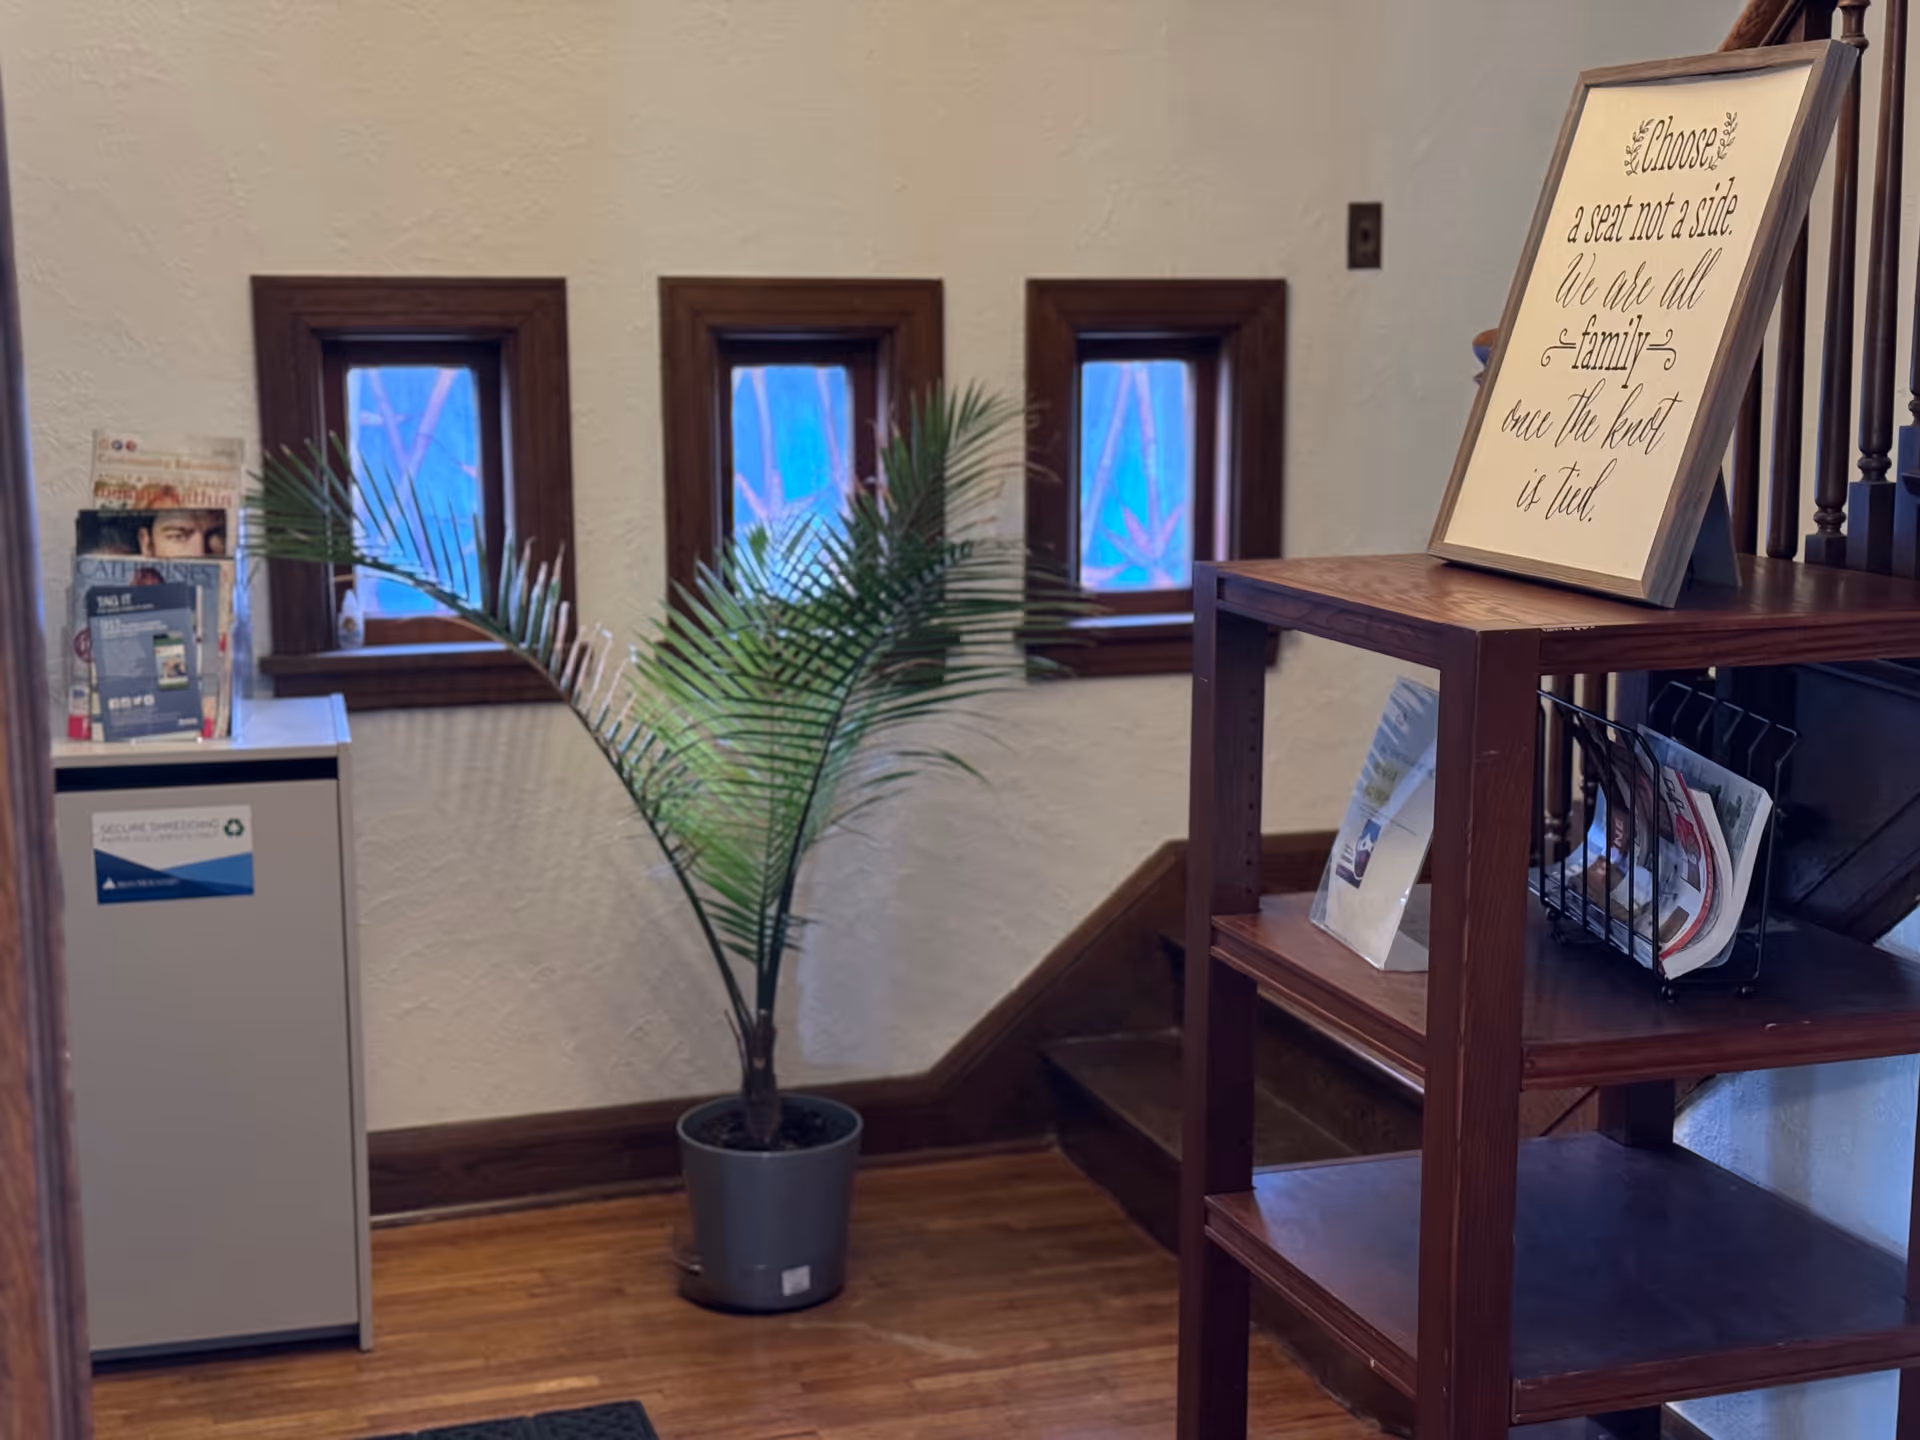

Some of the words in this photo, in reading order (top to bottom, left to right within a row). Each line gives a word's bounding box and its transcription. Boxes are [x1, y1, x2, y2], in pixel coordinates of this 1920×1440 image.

[1641, 115, 1718, 173] Choose
[1567, 205, 1584, 243] a
[1584, 195, 1633, 243] seat
[1629, 192, 1675, 241] not
[1671, 199, 1690, 239] a
[1688, 176, 1738, 239] side.
[1555, 252, 1599, 309] We
[1603, 261, 1655, 313] are
[1659, 247, 1722, 310] all
[1571, 313, 1651, 389] family
[1501, 399, 1553, 441] once
[1554, 378, 1606, 448] the
[1600, 383, 1683, 455] knot
[1516, 468, 1547, 512] is
[1545, 458, 1618, 522] tied.
